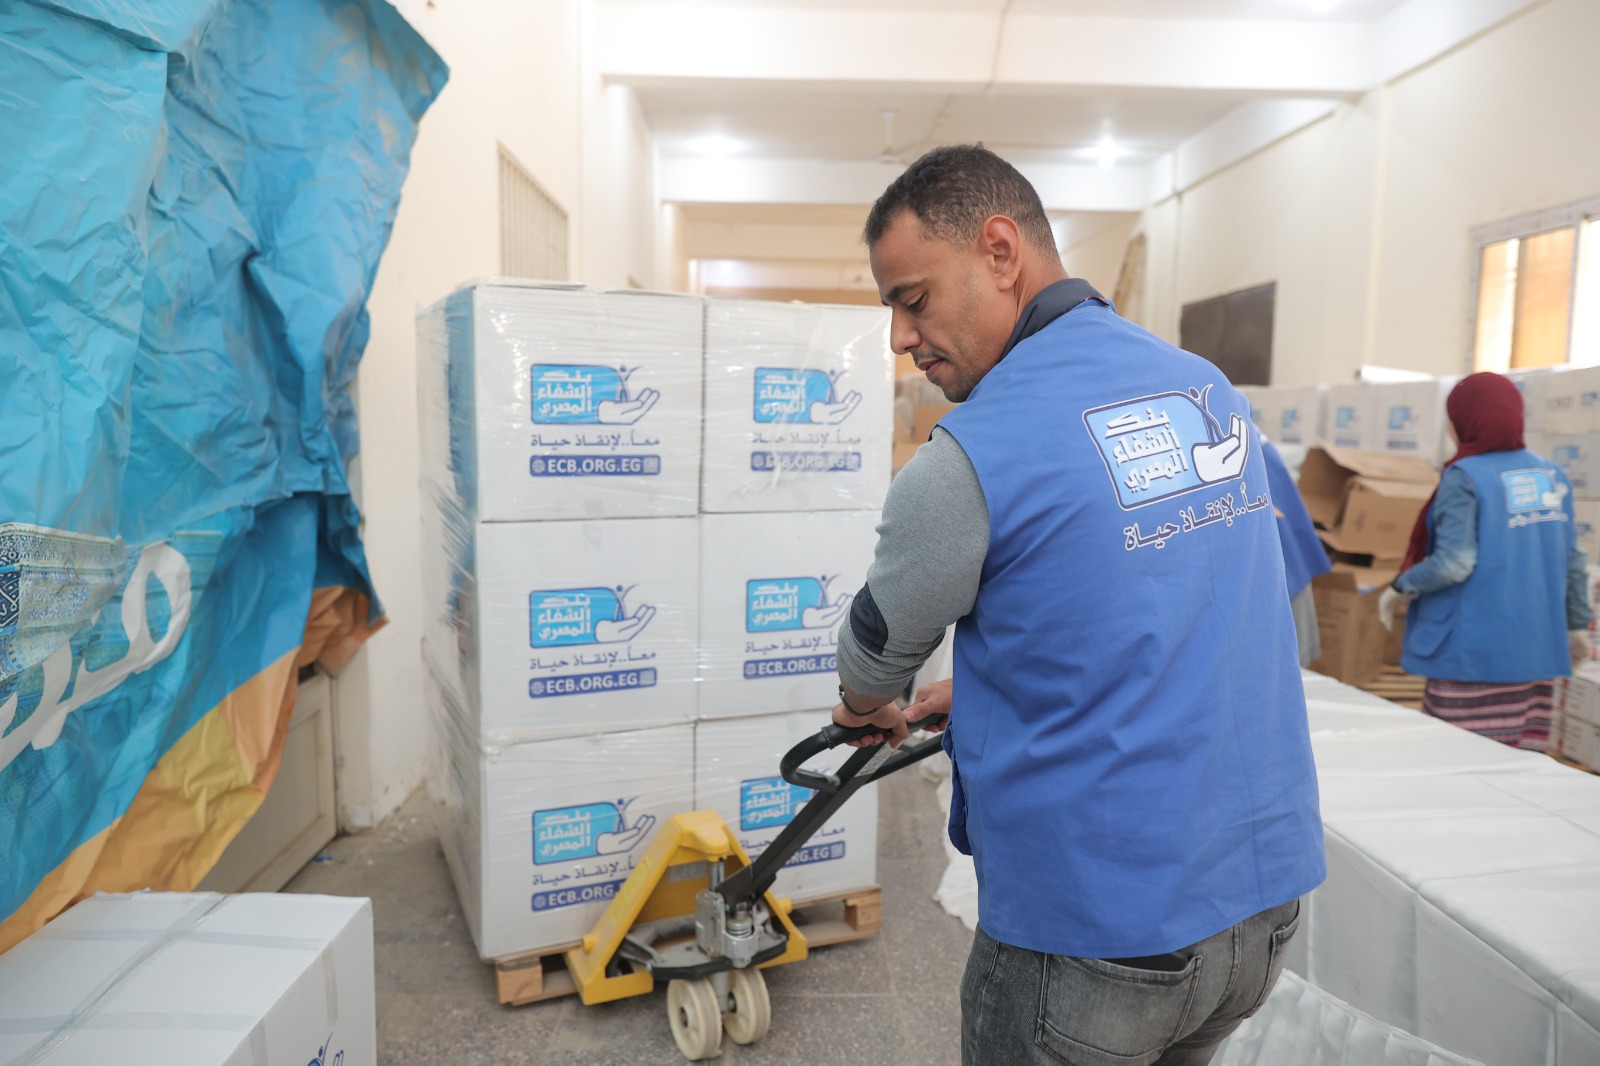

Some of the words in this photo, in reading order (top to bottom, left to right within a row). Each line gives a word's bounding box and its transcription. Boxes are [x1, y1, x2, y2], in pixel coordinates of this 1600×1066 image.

[539, 370, 592, 382] بنك
[538, 383, 592, 399] الشفاء
[1105, 407, 1171, 440] بنك
[531, 434, 571, 451] حياة
[1112, 425, 1182, 468] الشفاء
[547, 458, 641, 474] ECB.ORG.EG
[1123, 450, 1190, 494] المصري
[1123, 522, 1180, 551] حياة
[752, 582, 799, 596] بنك
[539, 593, 592, 608] بنك
[752, 594, 798, 612] الشفاء
[538, 606, 592, 626] الشفاء
[745, 641, 779, 656] حياة
[530, 658, 569, 673] حياة
[758, 657, 837, 676] ECB.ORG.EG
[546, 672, 638, 694] ECB.ORG.EG
[745, 791, 791, 811] الشفاء
[541, 811, 591, 826] بنك
[539, 822, 591, 842] الشفاء
[533, 874, 570, 887] حياة
